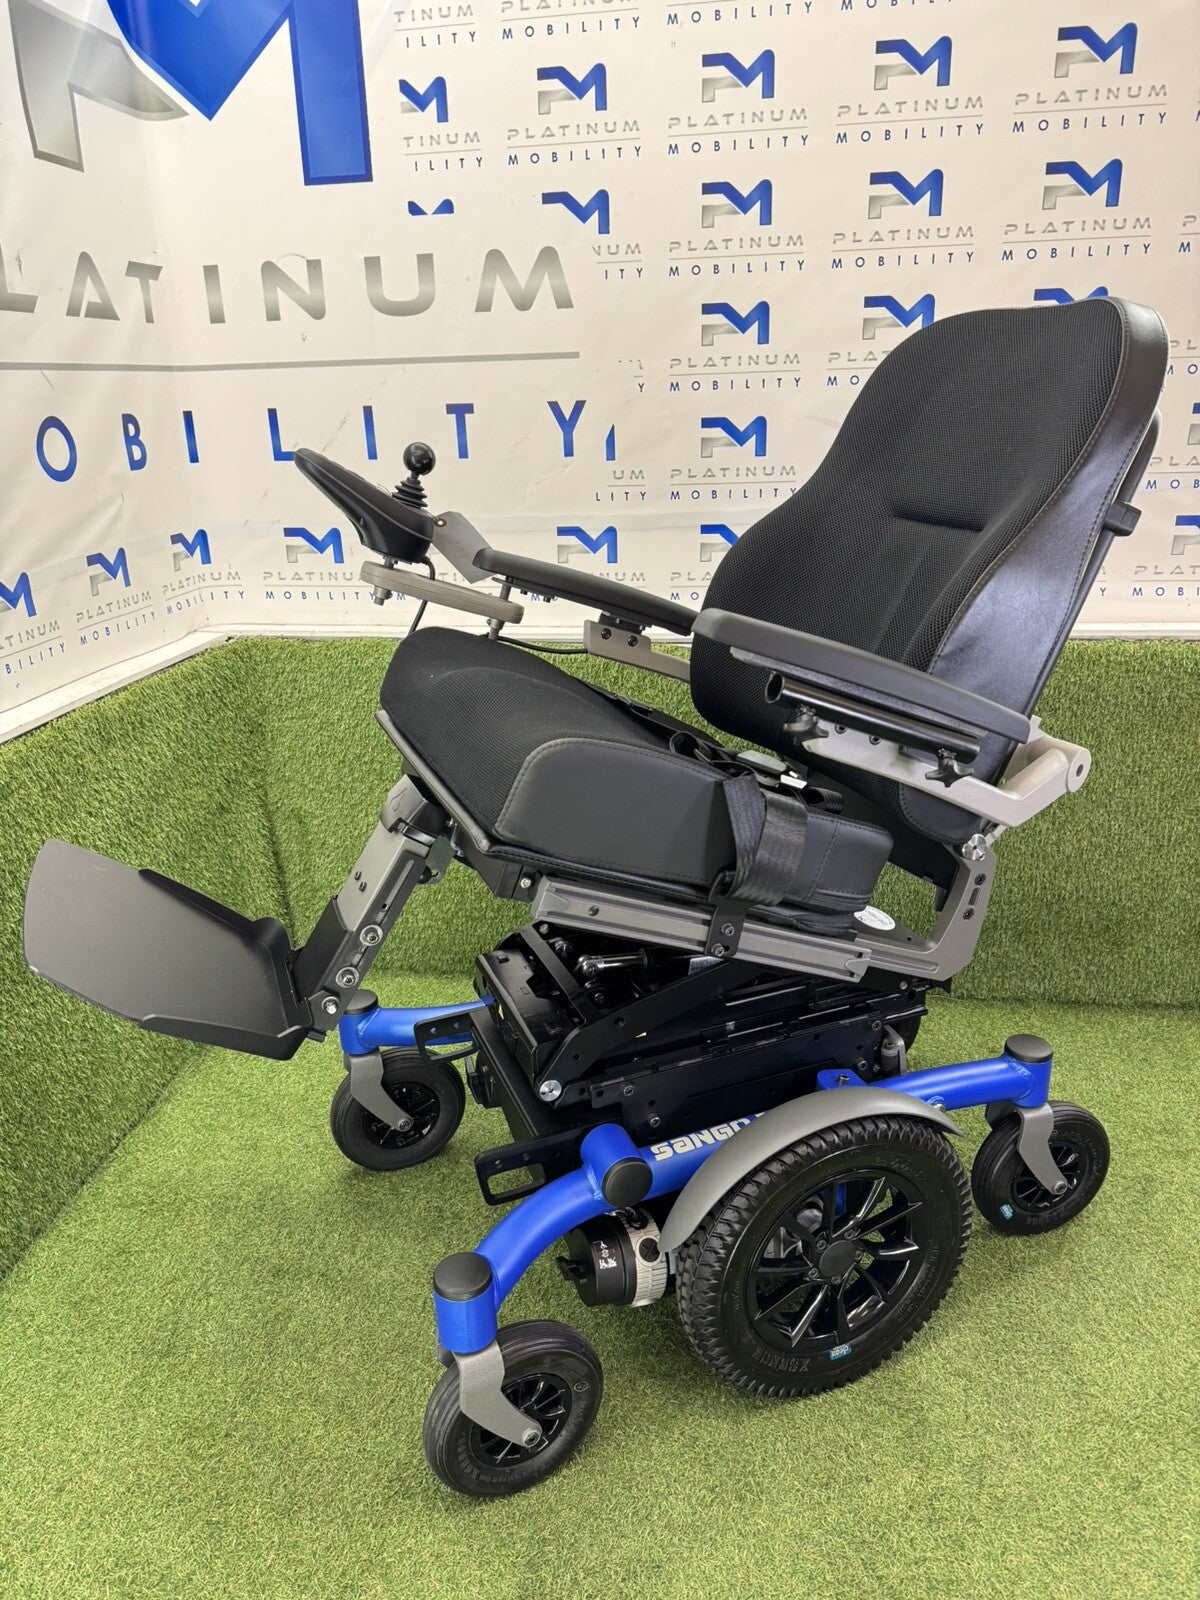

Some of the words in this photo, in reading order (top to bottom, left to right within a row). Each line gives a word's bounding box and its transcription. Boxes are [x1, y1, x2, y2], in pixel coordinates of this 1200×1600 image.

[667, 2, 812, 25] MOBILITY
[501, 16, 639, 39] MOBILITY
[1015, 84, 1167, 107] PLATINUM
[838, 96, 983, 118] PLATINUM
[668, 108, 808, 129] PLATINUM
[1011, 111, 1167, 133] MOBILITY
[507, 120, 640, 141] PLATINUM
[836, 123, 983, 144] MOBILITY
[667, 133, 808, 155] MOBILITY
[507, 145, 641, 165] MOBILITY
[833, 225, 974, 245] PLATINUM
[1004, 217, 1151, 236] PLATINUM
[669, 235, 804, 253] PLATINUM
[1001, 242, 1151, 261] MOBILITY
[669, 259, 804, 277] MOBILITY
[831, 250, 975, 269] MOBILITY
[670, 354, 800, 369] PLATINUM
[668, 377, 801, 392] MOBILITY
[671, 466, 795, 479] PLATINUM
[669, 486, 798, 502] MOBILITY
[163, 570, 242, 595] PLATINUM
[263, 572, 361, 581] PLATINU
[76, 590, 153, 624] PLATINUM
[165, 590, 244, 614] MOBILITY
[79, 610, 155, 646] MOBILITY
